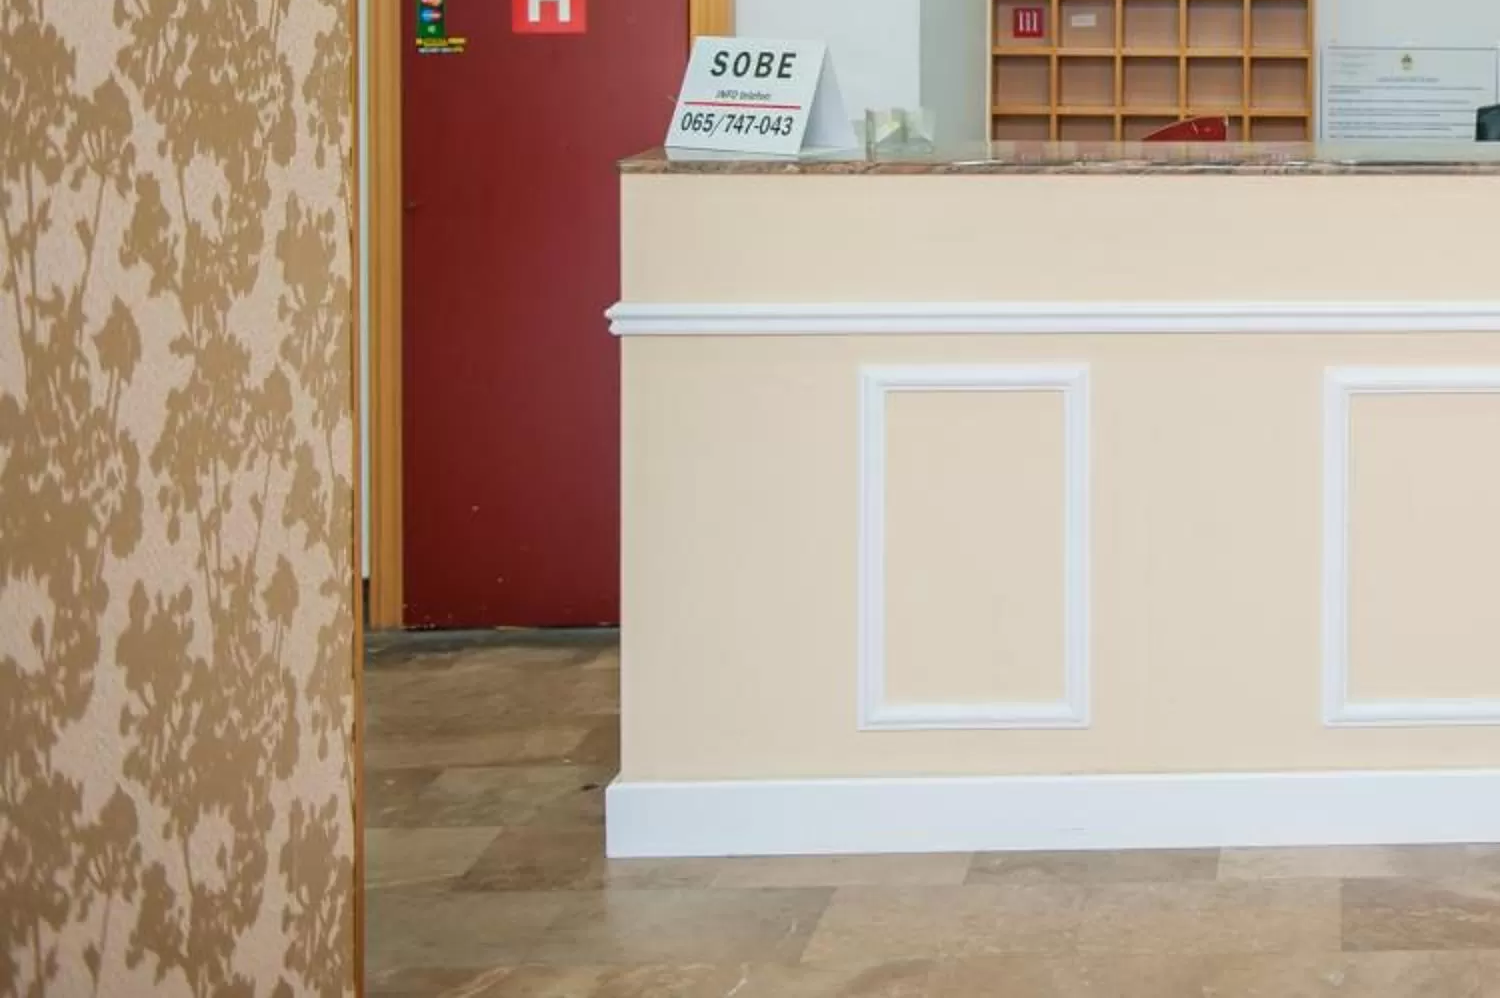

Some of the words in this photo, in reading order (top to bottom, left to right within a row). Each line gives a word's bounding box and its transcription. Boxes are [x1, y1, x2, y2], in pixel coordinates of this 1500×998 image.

[1018, 10, 1038, 33] 111
[710, 50, 797, 79] SOBE
[681, 112, 794, 138] 065/747-043
